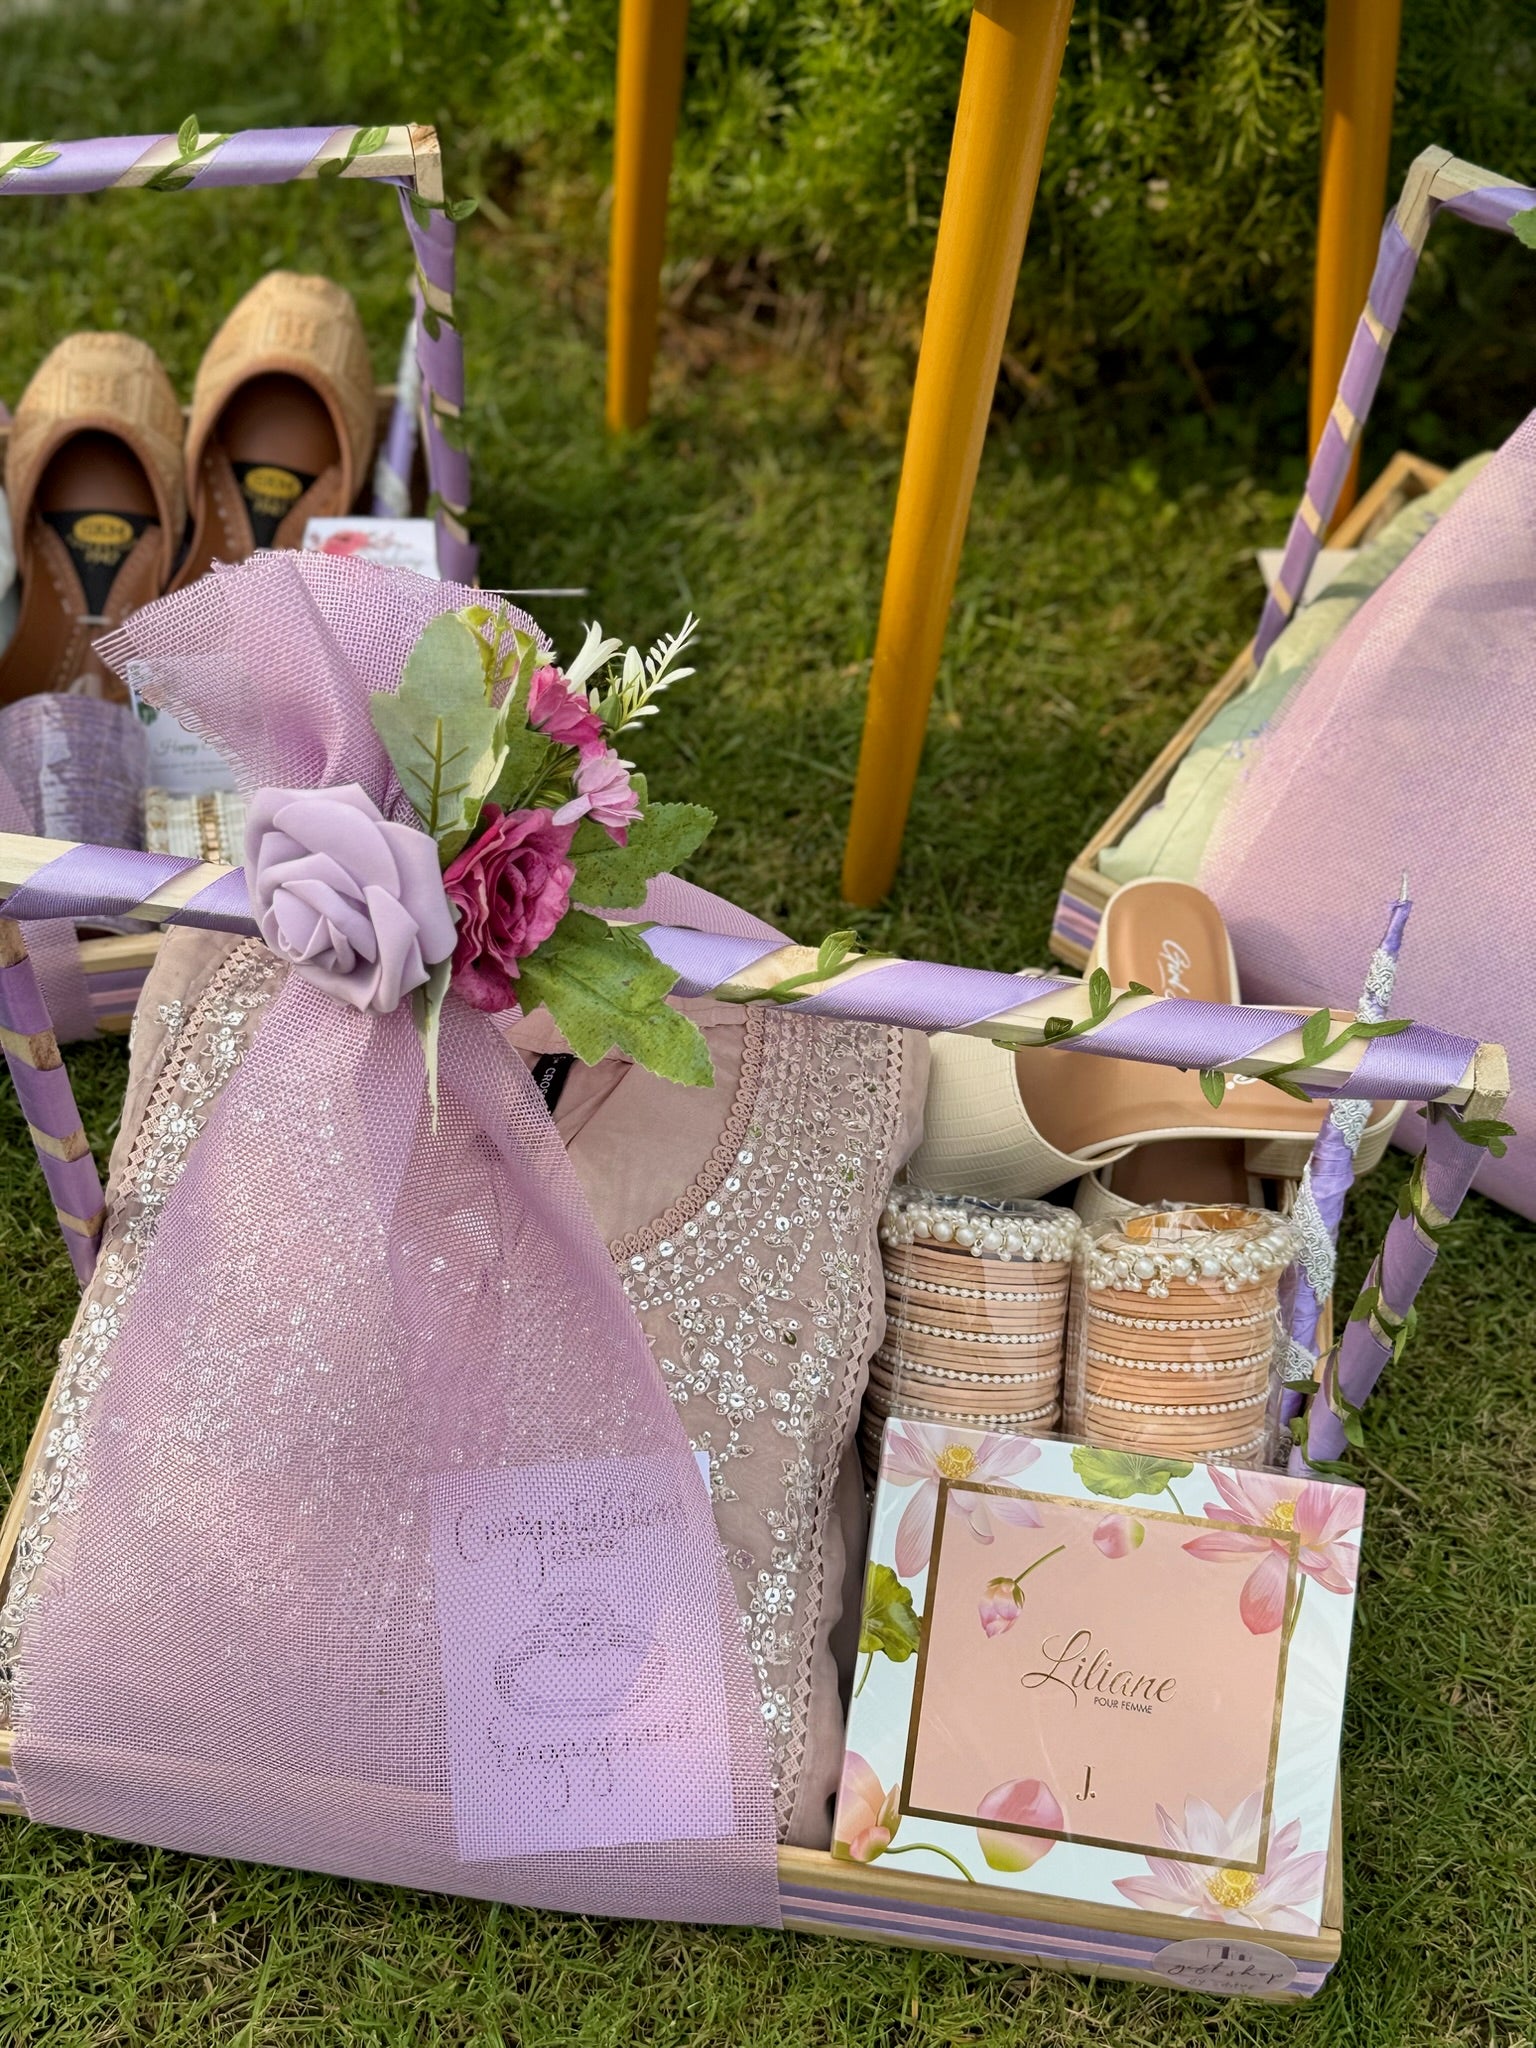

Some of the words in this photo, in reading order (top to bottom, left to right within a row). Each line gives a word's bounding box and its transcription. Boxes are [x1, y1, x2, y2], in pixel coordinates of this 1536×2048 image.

[1020, 1629, 1177, 1709] Liliane
[1093, 1696, 1119, 1709] POUR
[1120, 1701, 1153, 1714] FEMME
